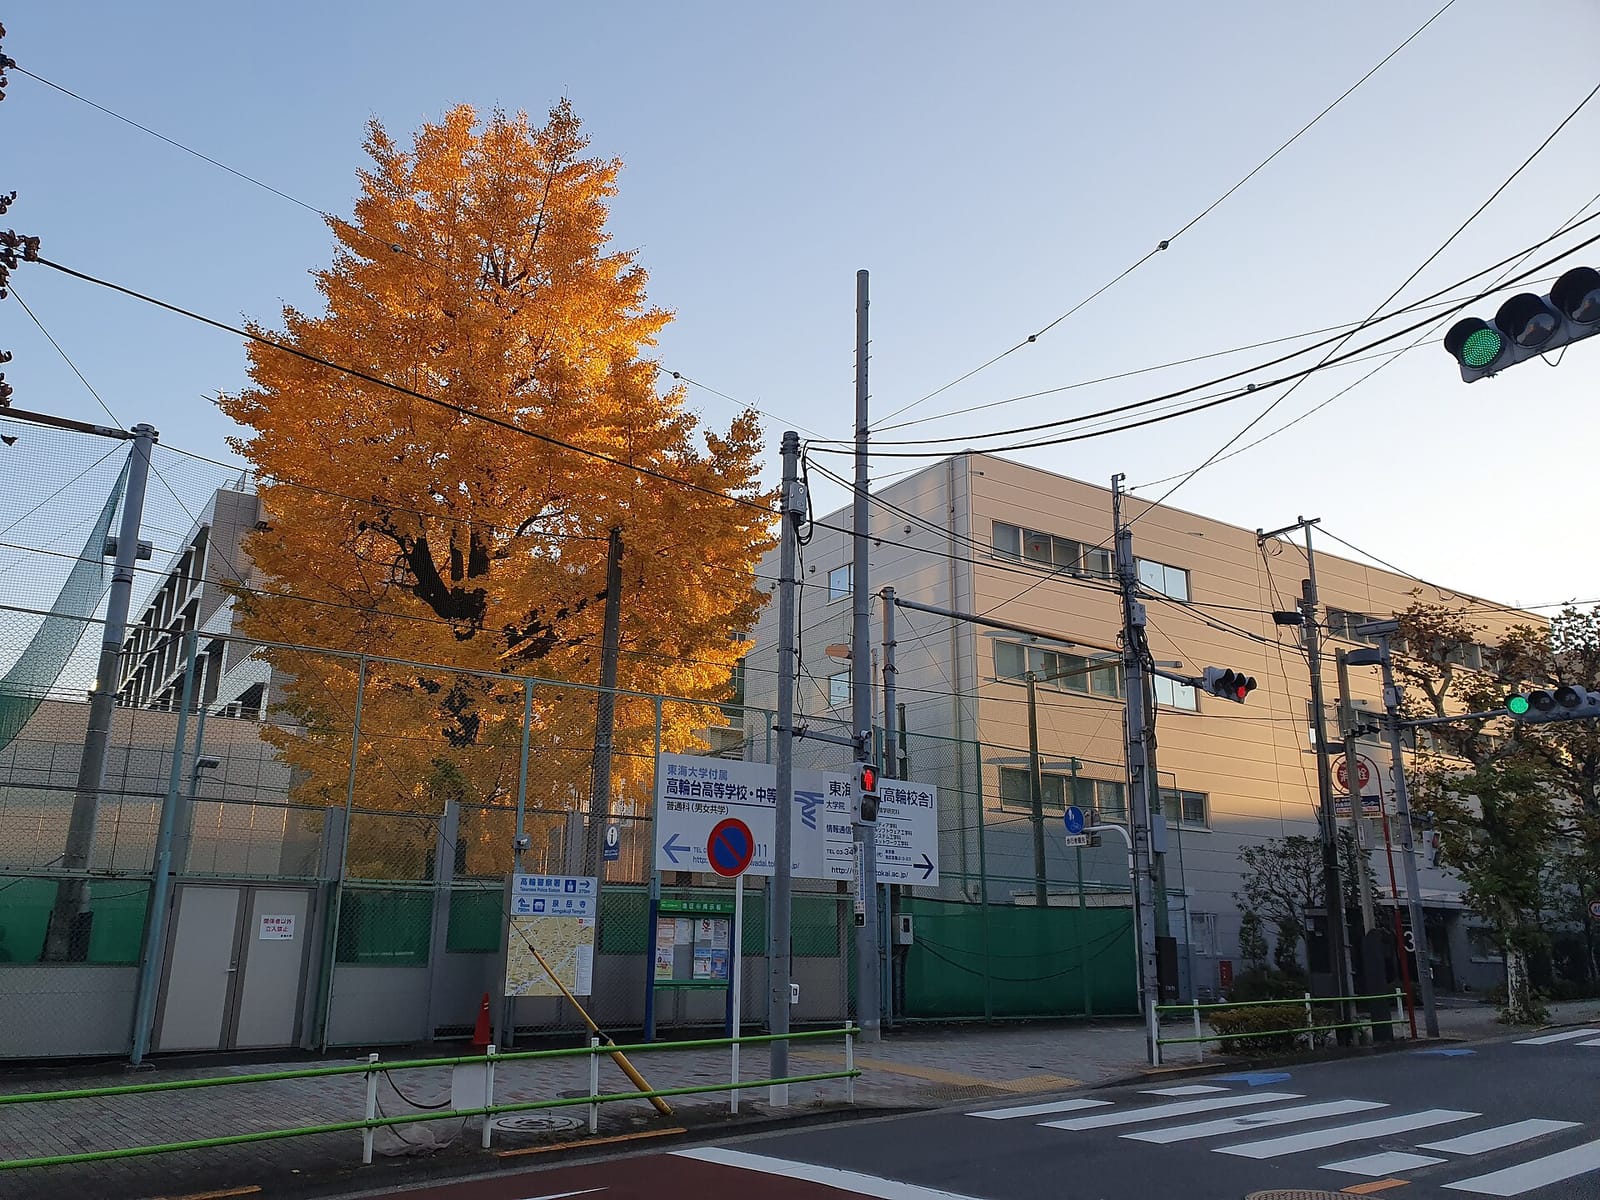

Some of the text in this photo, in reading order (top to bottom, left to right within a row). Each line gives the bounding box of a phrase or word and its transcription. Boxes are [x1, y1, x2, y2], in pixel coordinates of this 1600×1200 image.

[667, 764, 728, 780] 東海大学付属
[1339, 768, 1369, 784] 消栓
[667, 778, 777, 803] 高輪台高等学校・中等
[829, 781, 933, 808] 東海 [高輪校舎]
[826, 801, 845, 811] 大学院
[826, 825, 852, 836] 情報通信
